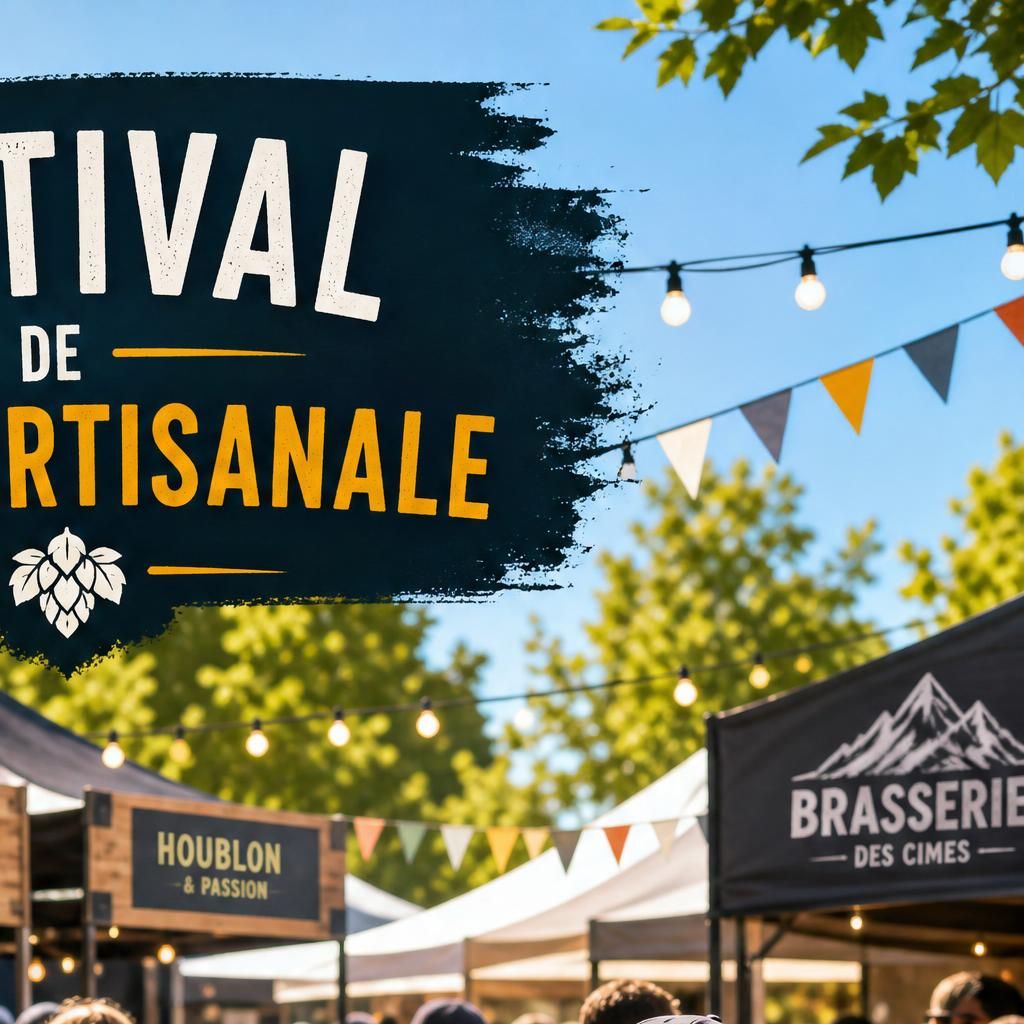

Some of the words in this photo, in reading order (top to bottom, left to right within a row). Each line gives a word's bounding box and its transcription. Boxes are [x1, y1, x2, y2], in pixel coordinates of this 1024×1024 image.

[790, 775, 1024, 839] BRASSERIE
[156, 831, 282, 875] HOUBLON
[854, 842, 895, 868] DES
[902, 840, 971, 866] CIMES
[182, 875, 195, 895] &
[200, 875, 269, 901] PASSION
